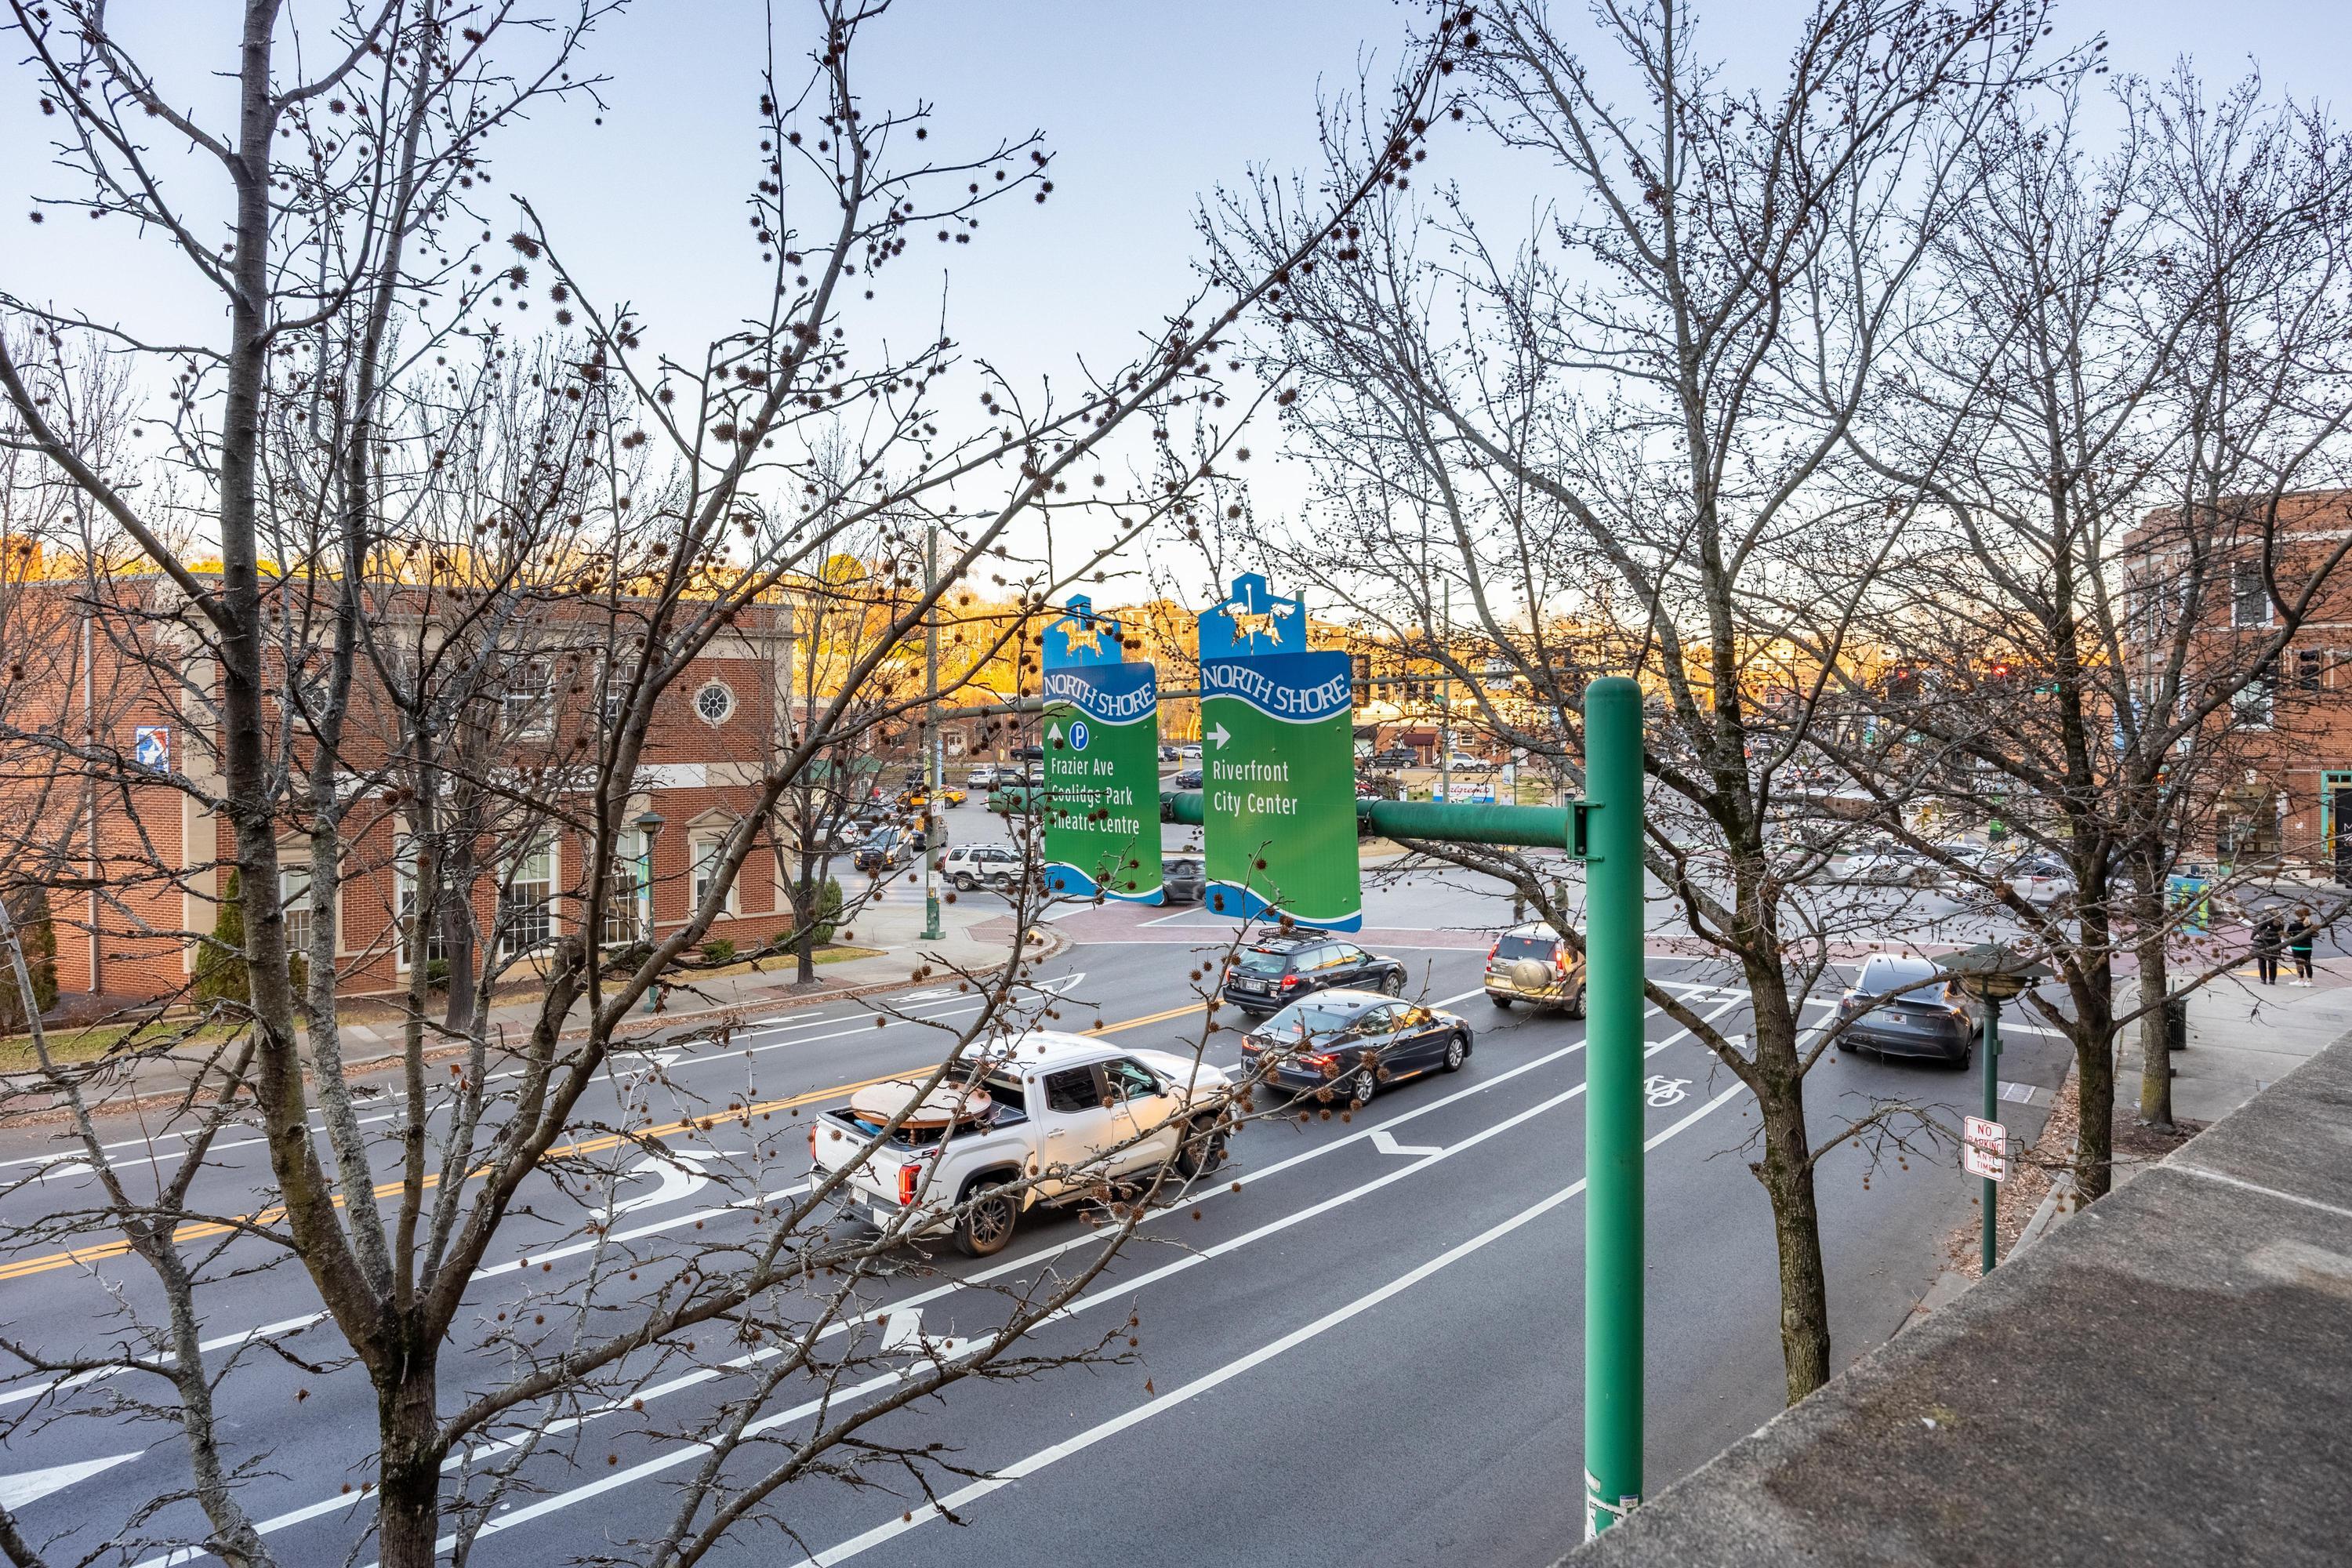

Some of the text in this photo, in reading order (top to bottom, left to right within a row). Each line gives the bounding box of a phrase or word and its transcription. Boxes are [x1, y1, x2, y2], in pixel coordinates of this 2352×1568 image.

[1044, 674, 1156, 717] NORTH SHORE
[1202, 665, 1351, 713] NORTH SHORE
[1075, 724, 1085, 747] P
[1051, 756, 1113, 776] Frazier Ave
[1213, 759, 1288, 782] Riverfront
[1052, 784, 1133, 808] Coolidge Park
[1214, 790, 1298, 817] City Center
[1052, 811, 1140, 835] Theatre Centre
[1978, 1124, 1991, 1136] NO
[1968, 1135, 2002, 1154] PARKING
[1976, 1152, 1993, 1162] ANY
